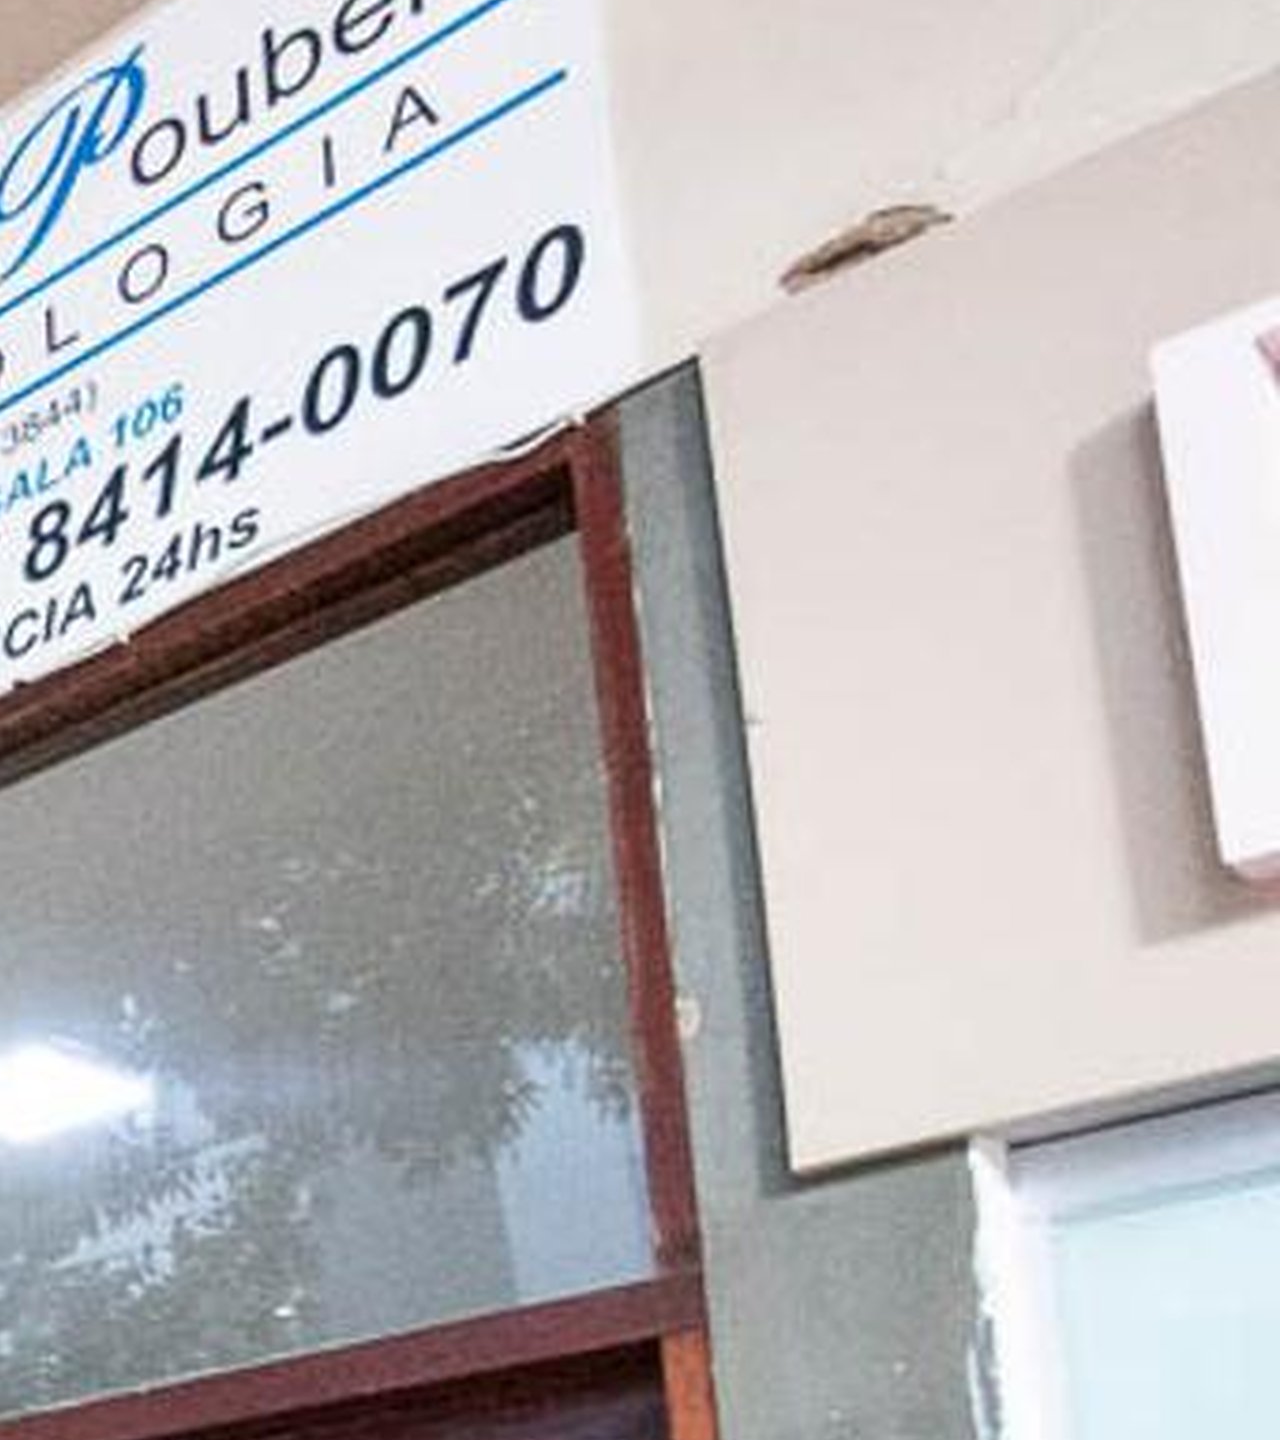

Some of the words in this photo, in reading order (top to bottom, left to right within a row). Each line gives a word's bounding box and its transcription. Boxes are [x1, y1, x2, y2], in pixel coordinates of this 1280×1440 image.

[23, 223, 586, 583] 8414-0070
[112, 382, 185, 448] 106
[119, 505, 260, 607] 24hs
